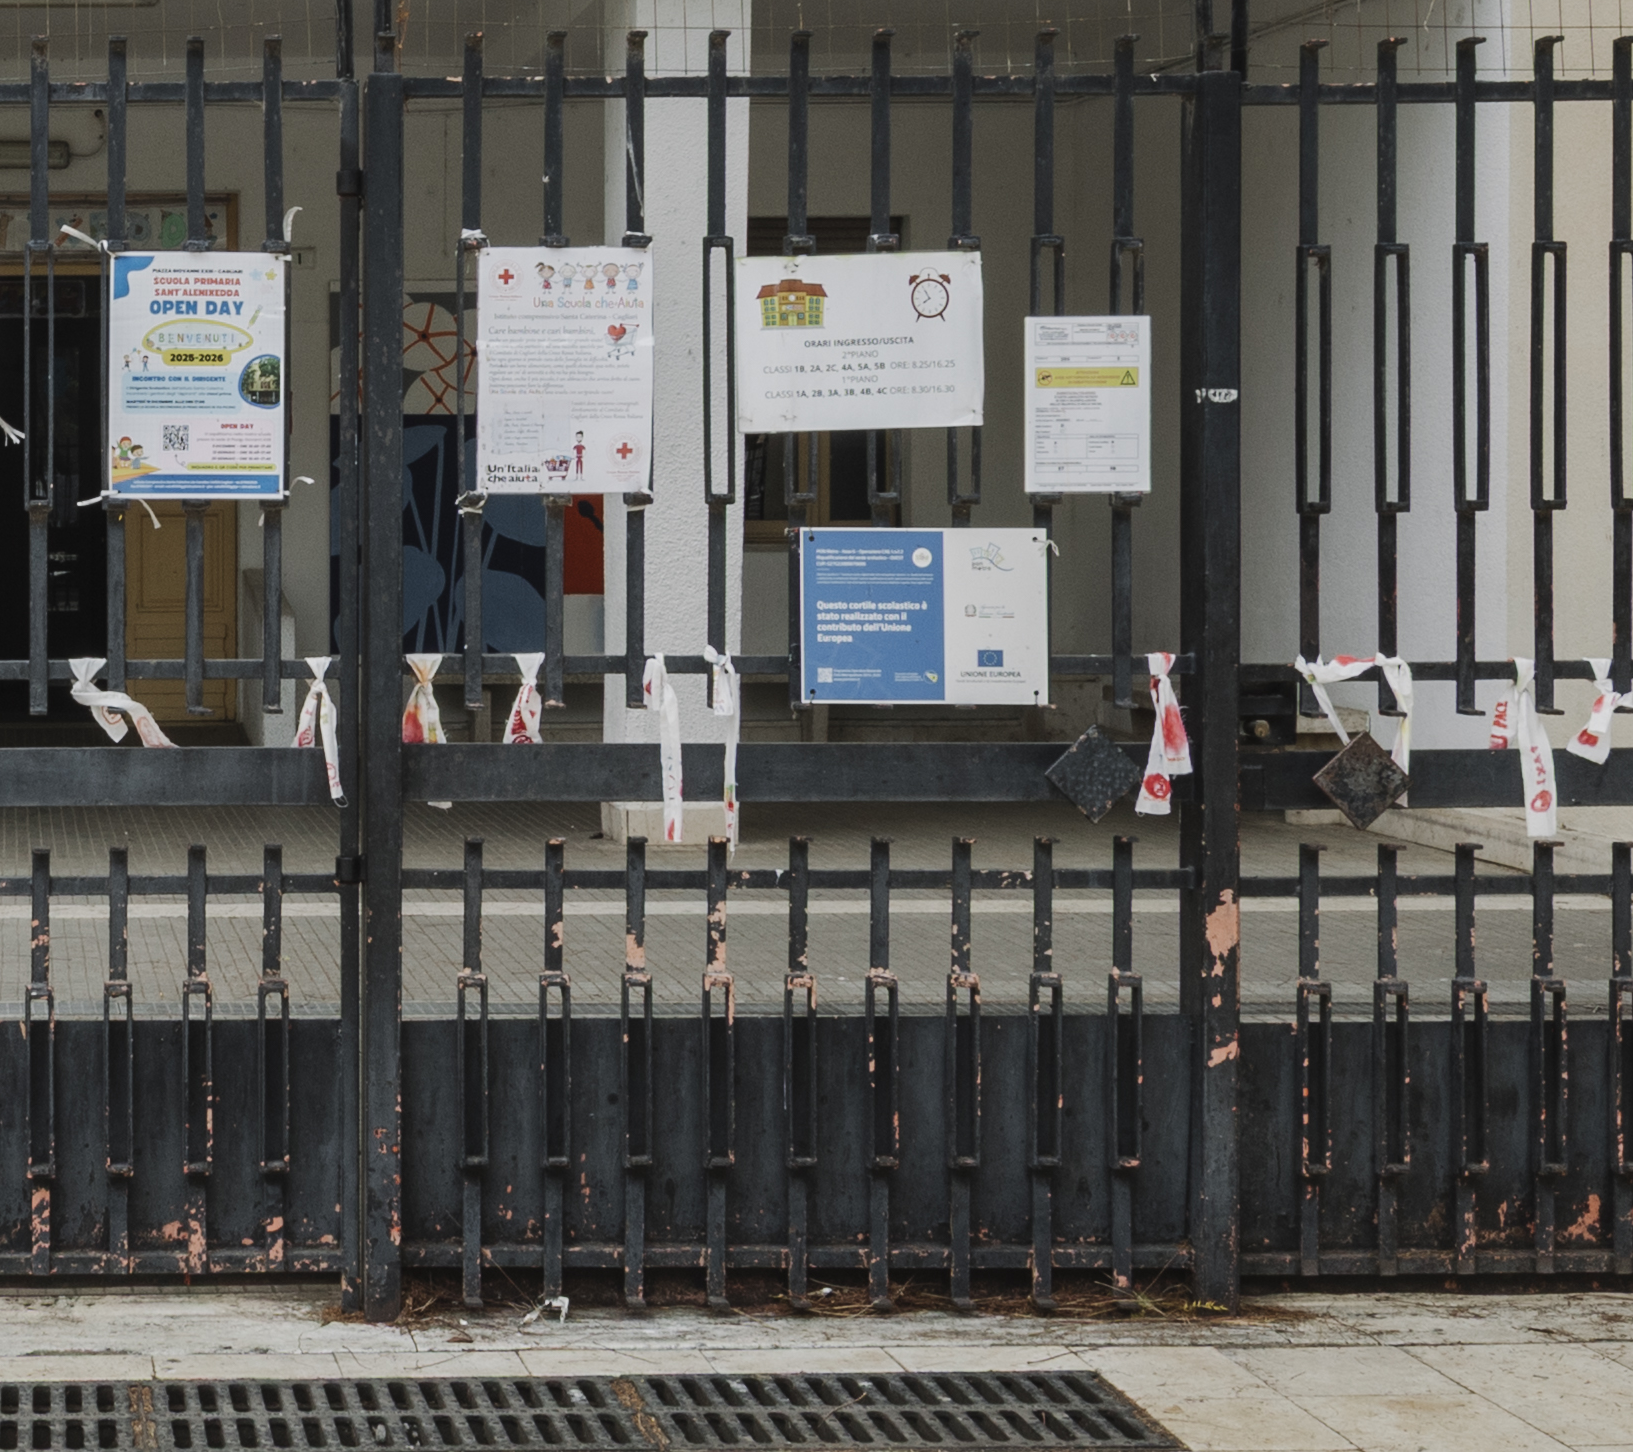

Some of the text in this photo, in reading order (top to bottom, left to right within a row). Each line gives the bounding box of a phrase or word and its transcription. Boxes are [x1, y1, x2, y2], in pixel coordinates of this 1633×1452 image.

[153, 276, 241, 286] SCUOLA PRIMARIA
[533, 296, 554, 308] Una
[557, 296, 592, 308] Scuola
[149, 300, 244, 316] OPEN DAY
[494, 312, 517, 320] Istituto
[517, 313, 560, 321] comprensivo
[612, 313, 638, 321] Cagliari
[488, 326, 506, 335] Care
[507, 326, 540, 335] bambine
[547, 327, 562, 335] cari
[158, 332, 235, 343] BENVENUTI
[804, 336, 914, 348] ORARI INGRESSO/USCITA
[170, 353, 224, 362] 2025-2026
[762, 365, 793, 375] CLASSI
[809, 364, 823, 374] 2A,
[841, 363, 854, 372] 4A,
[857, 362, 871, 372] 5A,
[874, 362, 886, 370] 5B
[890, 361, 910, 370] ORE:
[911, 359, 956, 369] 8.25/16.25
[764, 390, 794, 400] CLASSI
[796, 390, 809, 399] 1A,
[876, 387, 888, 395] 4C
[889, 386, 910, 395] ORE:
[911, 384, 956, 394] 8.30/16.30
[487, 464, 539, 474] Un'Italia
[487, 473, 538, 483] che aiuta
[816, 600, 928, 611] Questo cortile scolastico è
[816, 612, 907, 621] stato realizzato con il
[816, 623, 912, 632] contributo dell'Unione
[816, 634, 853, 644] Europea
